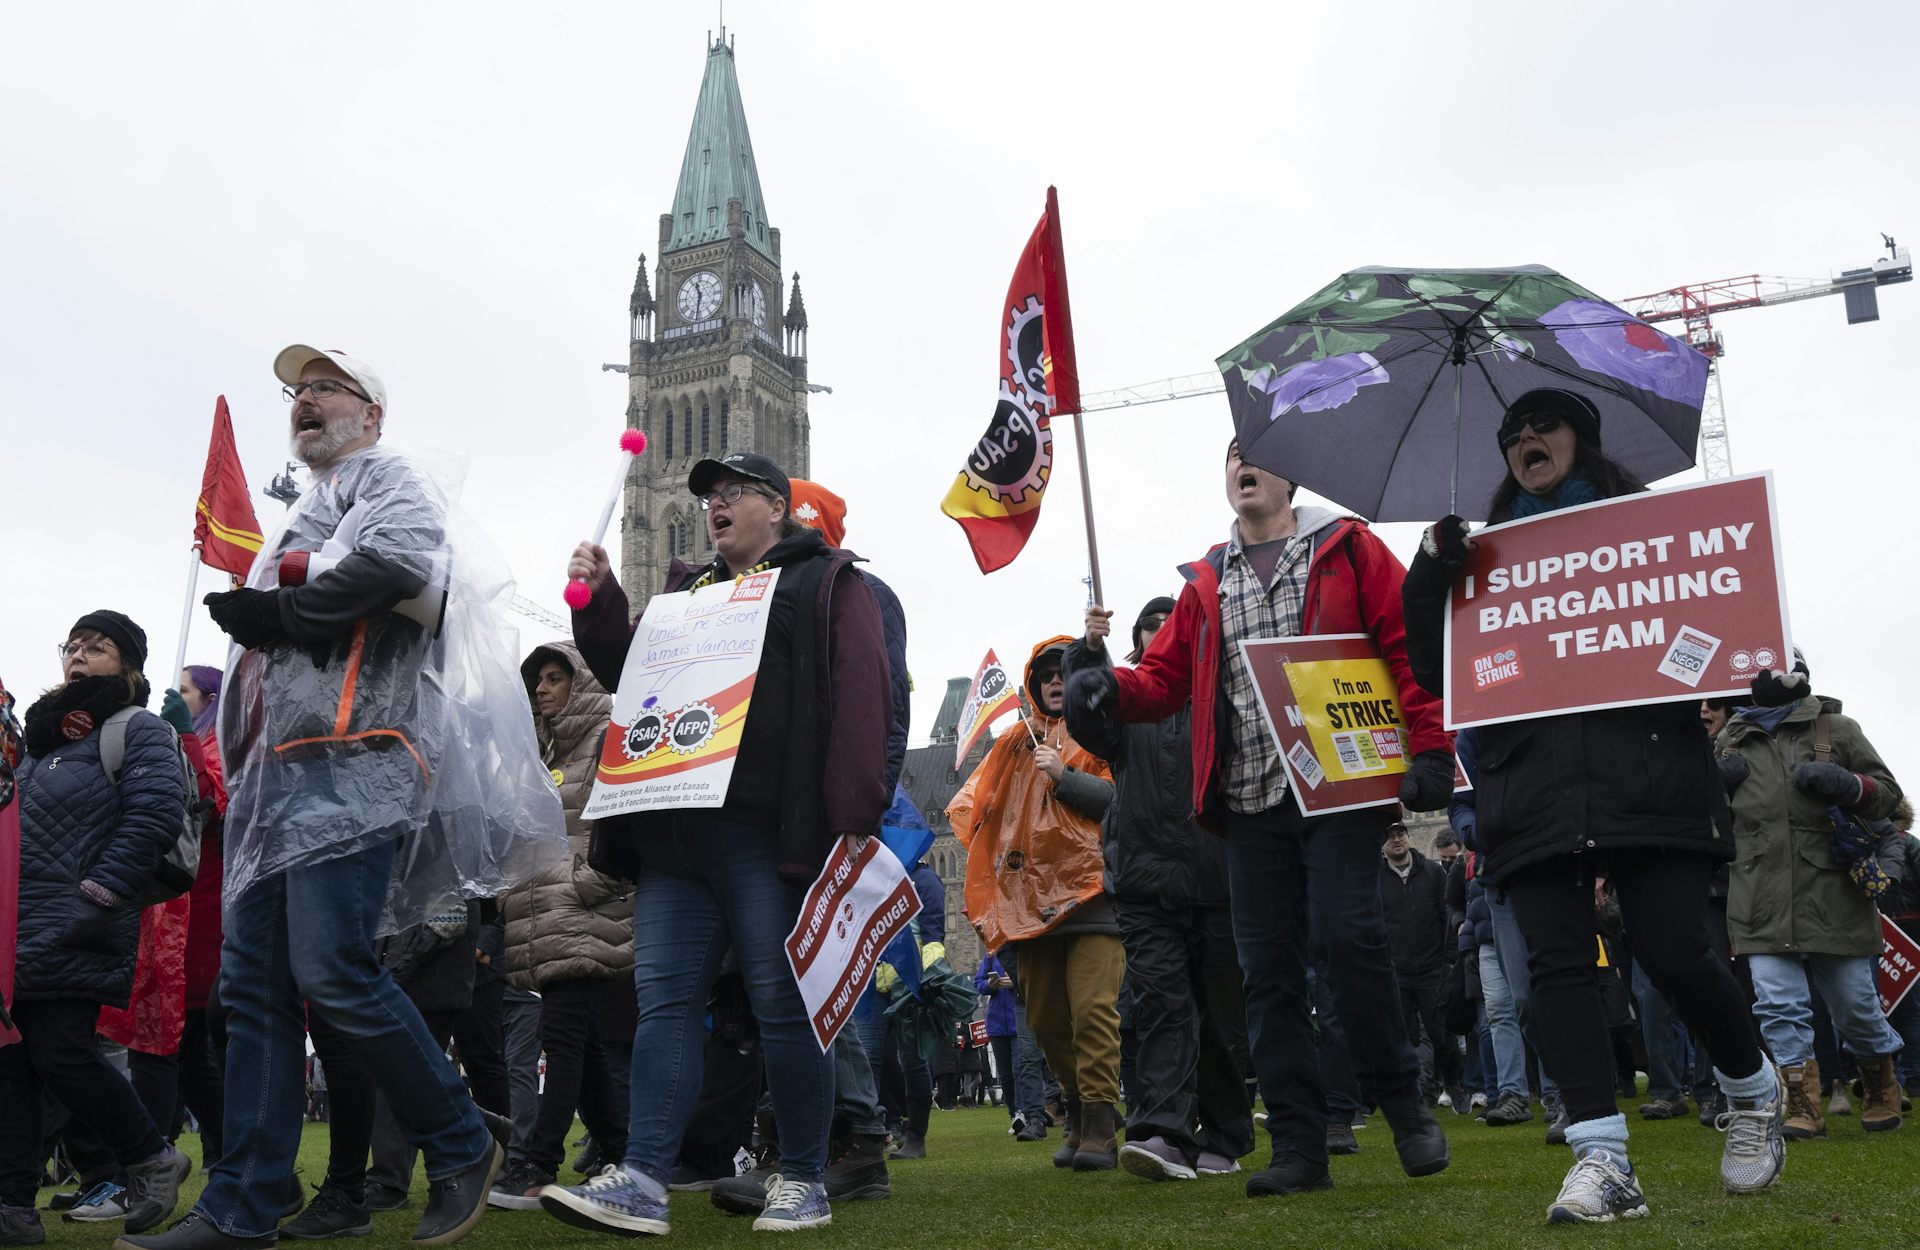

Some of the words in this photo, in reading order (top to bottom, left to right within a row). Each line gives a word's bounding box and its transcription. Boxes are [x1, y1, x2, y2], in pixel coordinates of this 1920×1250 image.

[1465, 575, 1475, 600] I
[1487, 535, 1675, 594] SUPPORT
[1688, 522, 1755, 557] MY
[733, 586, 764, 599] STRIKE
[738, 579, 753, 589] ON
[1479, 566, 1742, 634] BARGAINING
[1548, 617, 1666, 659] TEAM
[1474, 655, 1493, 673] ON
[1671, 651, 1701, 672] NÉGO
[981, 671, 1005, 697] AFPC
[1476, 661, 1520, 687] STRIKE
[1730, 671, 1760, 682] psacuni
[1333, 678, 1355, 695] I'm
[1356, 680, 1373, 694] on
[1326, 699, 1401, 730] STRIKE
[629, 725, 659, 743] PSAC
[675, 720, 709, 737] AFPC
[1372, 732, 1386, 744] ON
[600, 791, 618, 801] Public
[619, 788, 643, 798] Service
[643, 784, 671, 794] Alliance
[673, 782, 682, 791] of
[682, 782, 710, 791] Canada
[586, 804, 610, 813] Alliance
[610, 802, 618, 810] de
[618, 800, 624, 808] la
[625, 797, 652, 807] Fonction
[652, 794, 681, 804] publique
[682, 792, 692, 801] du
[693, 793, 720, 801] Canada
[796, 928, 815, 960] UNE
[810, 881, 836, 935] ENTENTE
[822, 1013, 835, 1031] IL
[832, 980, 853, 1018] FAUT
[850, 954, 867, 986] QUE
[862, 938, 874, 963] ÇA
[870, 894, 910, 944] BOUGE!
[1893, 952, 1916, 973] MY
